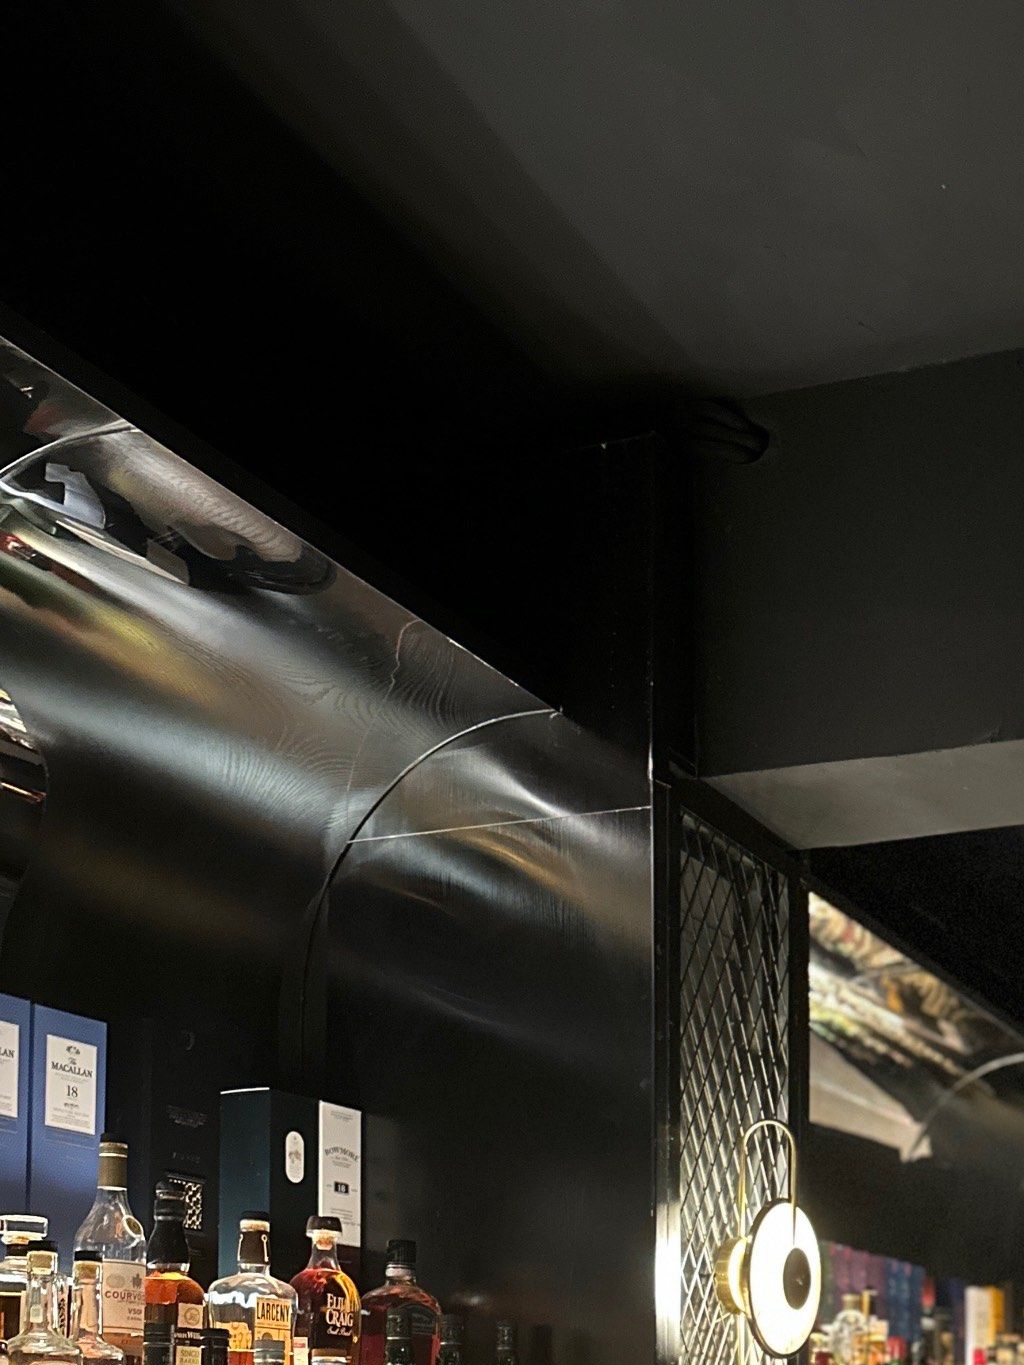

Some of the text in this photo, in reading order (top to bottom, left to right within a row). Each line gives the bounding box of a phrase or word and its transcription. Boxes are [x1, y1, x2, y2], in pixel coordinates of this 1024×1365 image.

[51, 1061, 93, 1078] MACALLAN
[66, 1085, 78, 1098] 18
[337, 1184, 346, 1193] 18
[256, 1301, 289, 1322] LARCENY
[326, 1308, 354, 1327] CRAIG
